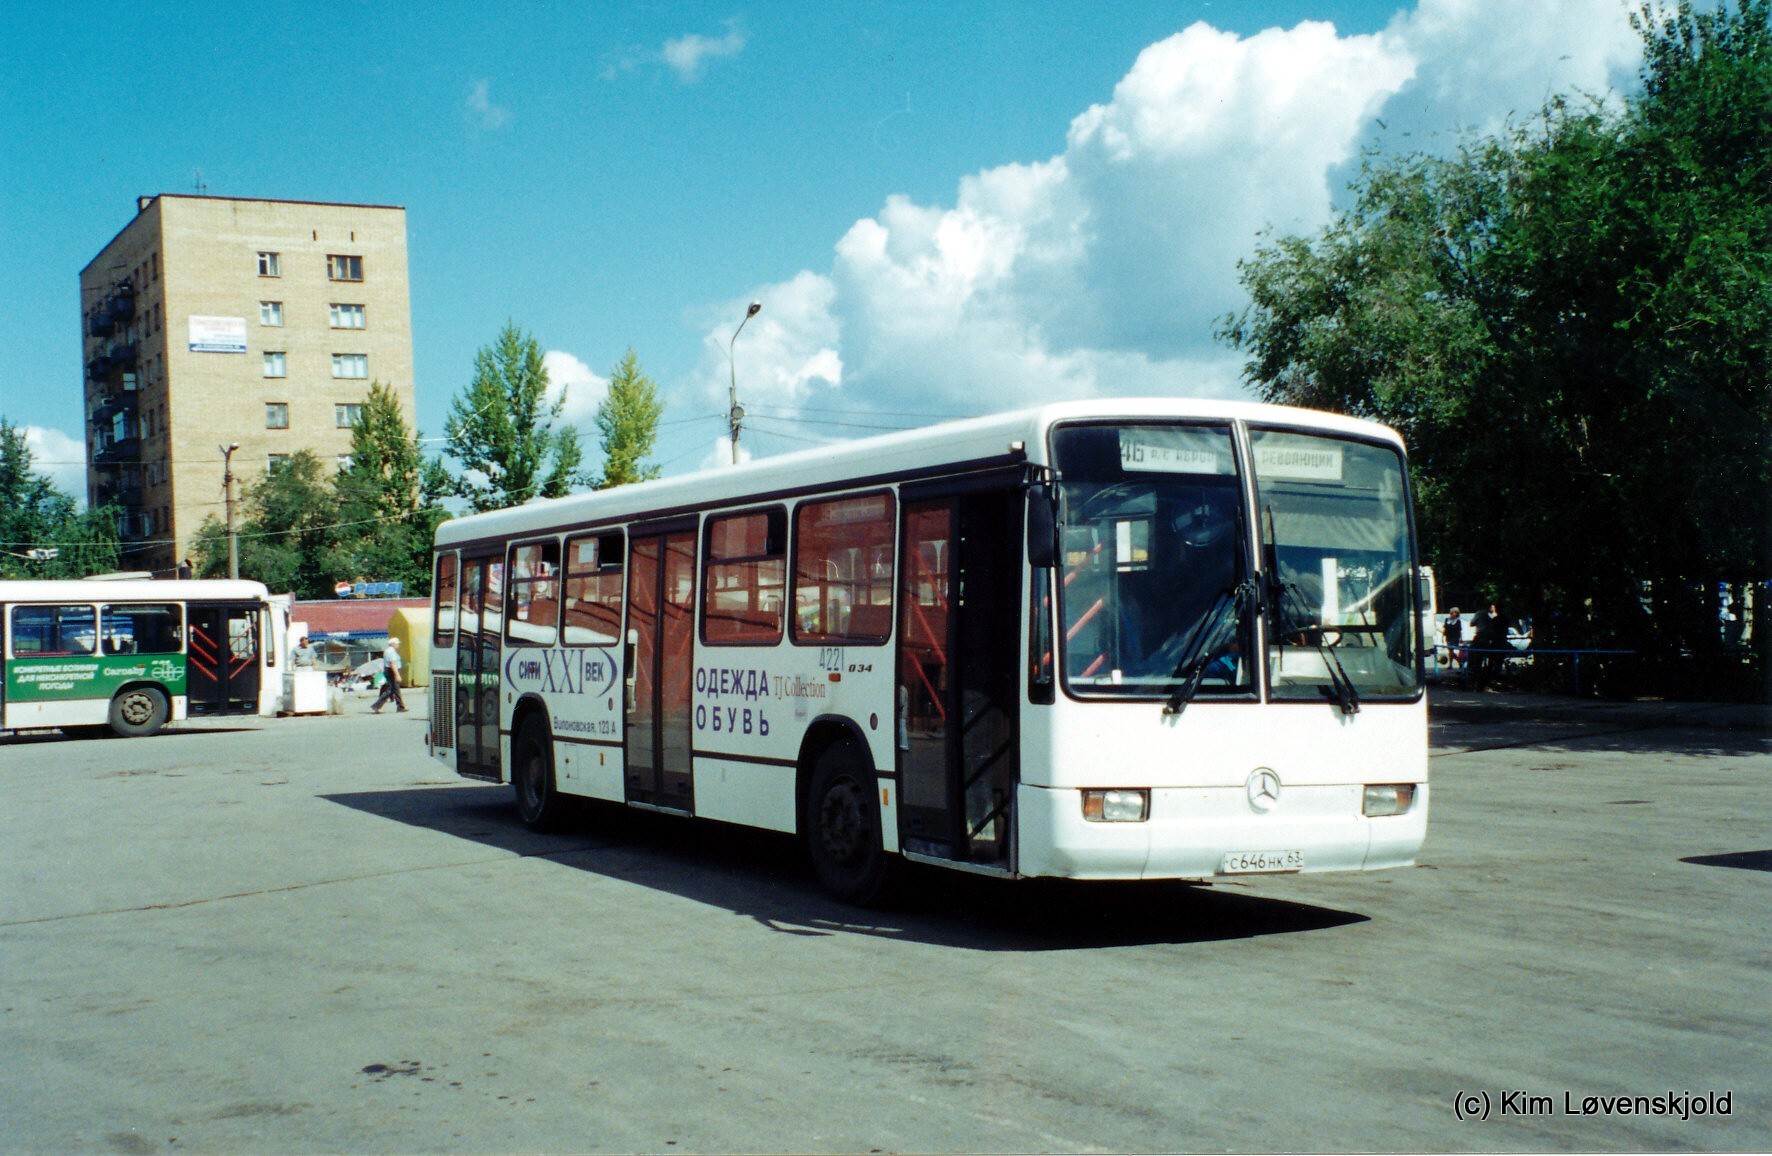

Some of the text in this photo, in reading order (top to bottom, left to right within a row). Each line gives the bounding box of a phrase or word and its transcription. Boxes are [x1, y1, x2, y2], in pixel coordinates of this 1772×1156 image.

[354, 582, 403, 595] PEPSI
[541, 649, 585, 694] XXI
[585, 662, 604, 681] ВЕК
[848, 664, 872, 673] 034
[17, 675, 35, 683] ДЛЯ
[696, 667, 769, 700] ОДЕЖДА
[784, 676, 826, 698] Collection
[611, 721, 617, 735] А
[696, 704, 769, 736] ОБУВЬ
